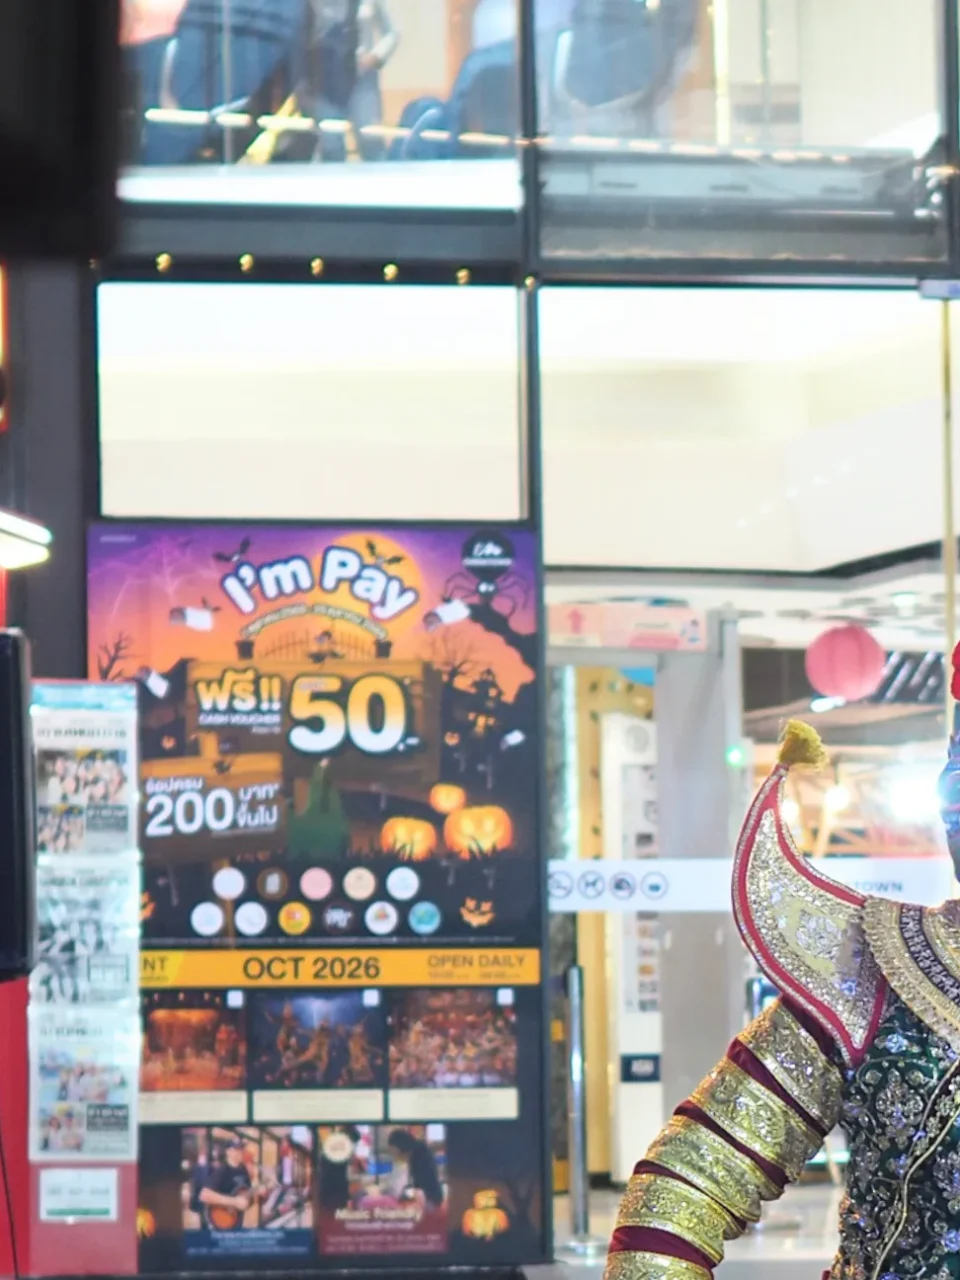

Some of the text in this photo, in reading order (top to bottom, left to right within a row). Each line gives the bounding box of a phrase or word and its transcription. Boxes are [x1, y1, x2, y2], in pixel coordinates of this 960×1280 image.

[222, 558, 314, 615] I'm
[320, 547, 419, 621] Pay
[145, 788, 234, 838] 200
[243, 956, 305, 981] OCT
[312, 956, 381, 981] 2026
[427, 953, 474, 968] OPEN
[477, 953, 526, 968] DAILY
